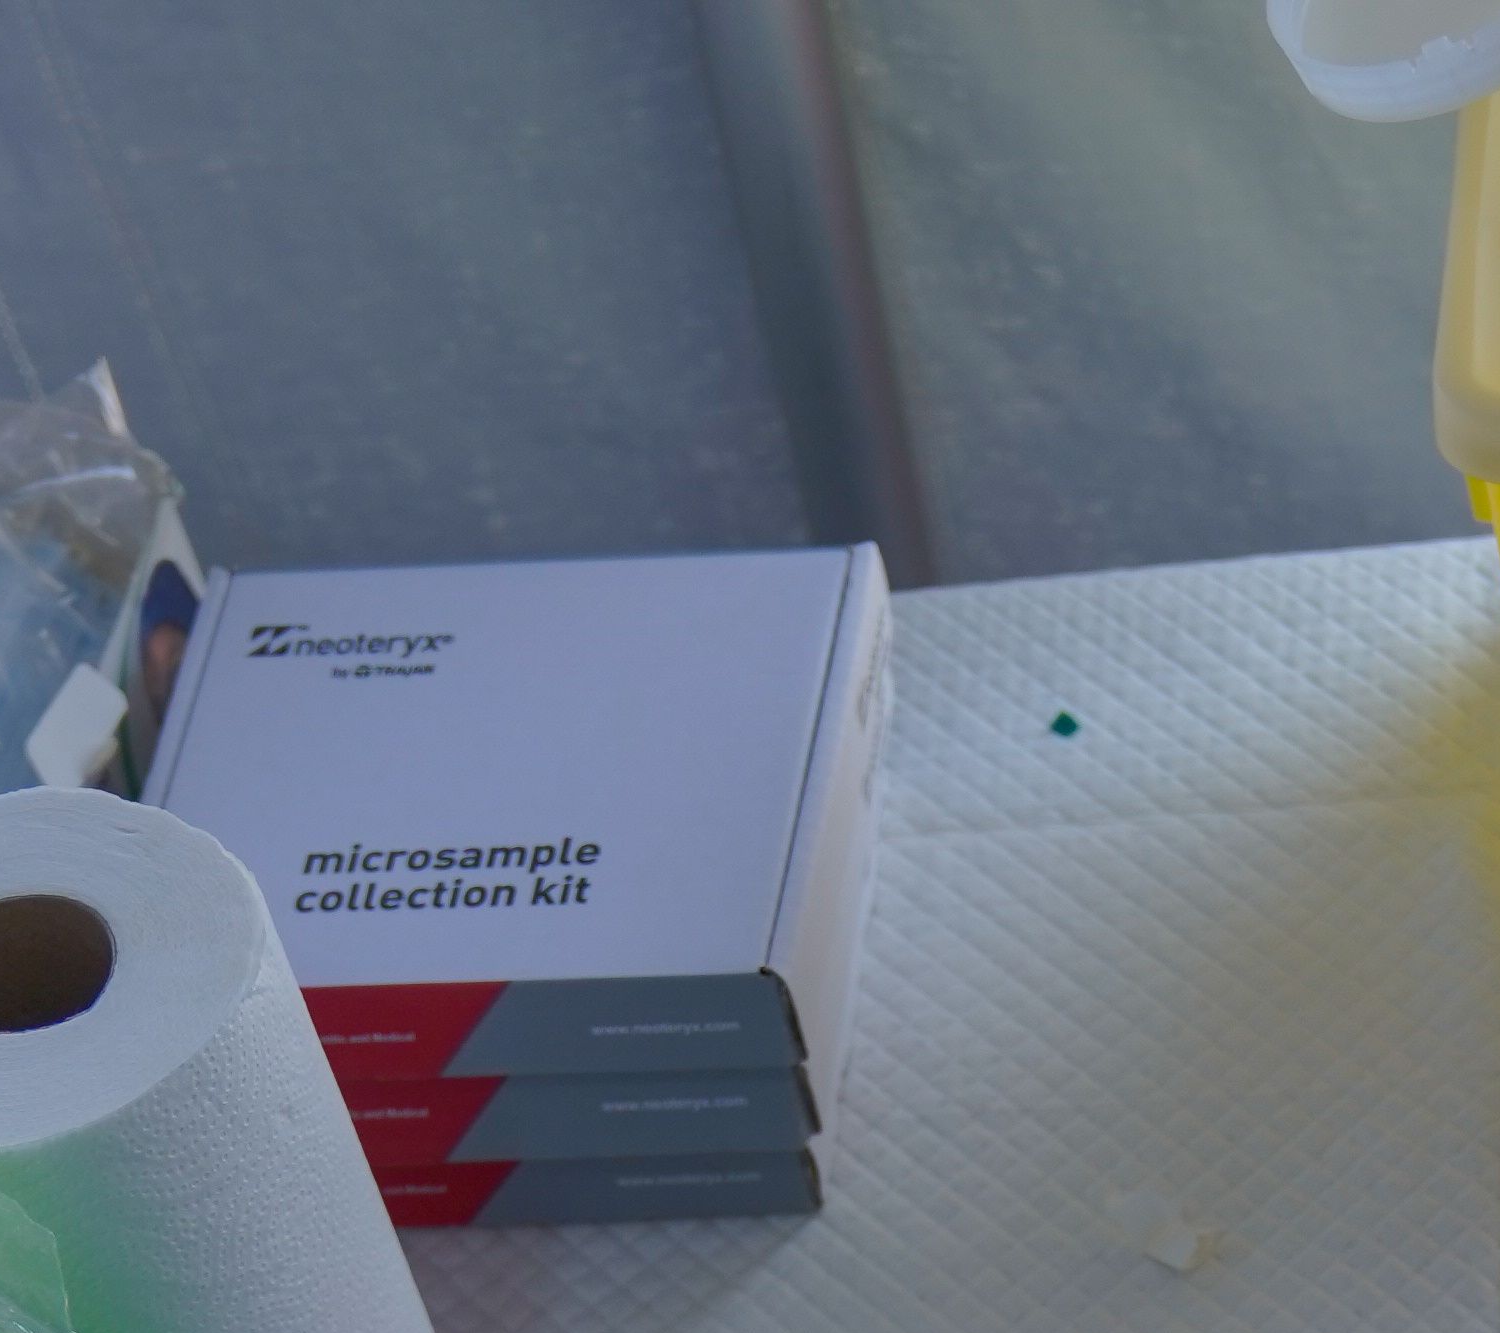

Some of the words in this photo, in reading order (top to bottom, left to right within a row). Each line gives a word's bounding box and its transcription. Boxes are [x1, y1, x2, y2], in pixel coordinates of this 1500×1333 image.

[301, 835, 602, 876] microsample
[293, 876, 518, 915] collection
[529, 872, 592, 907] kit
